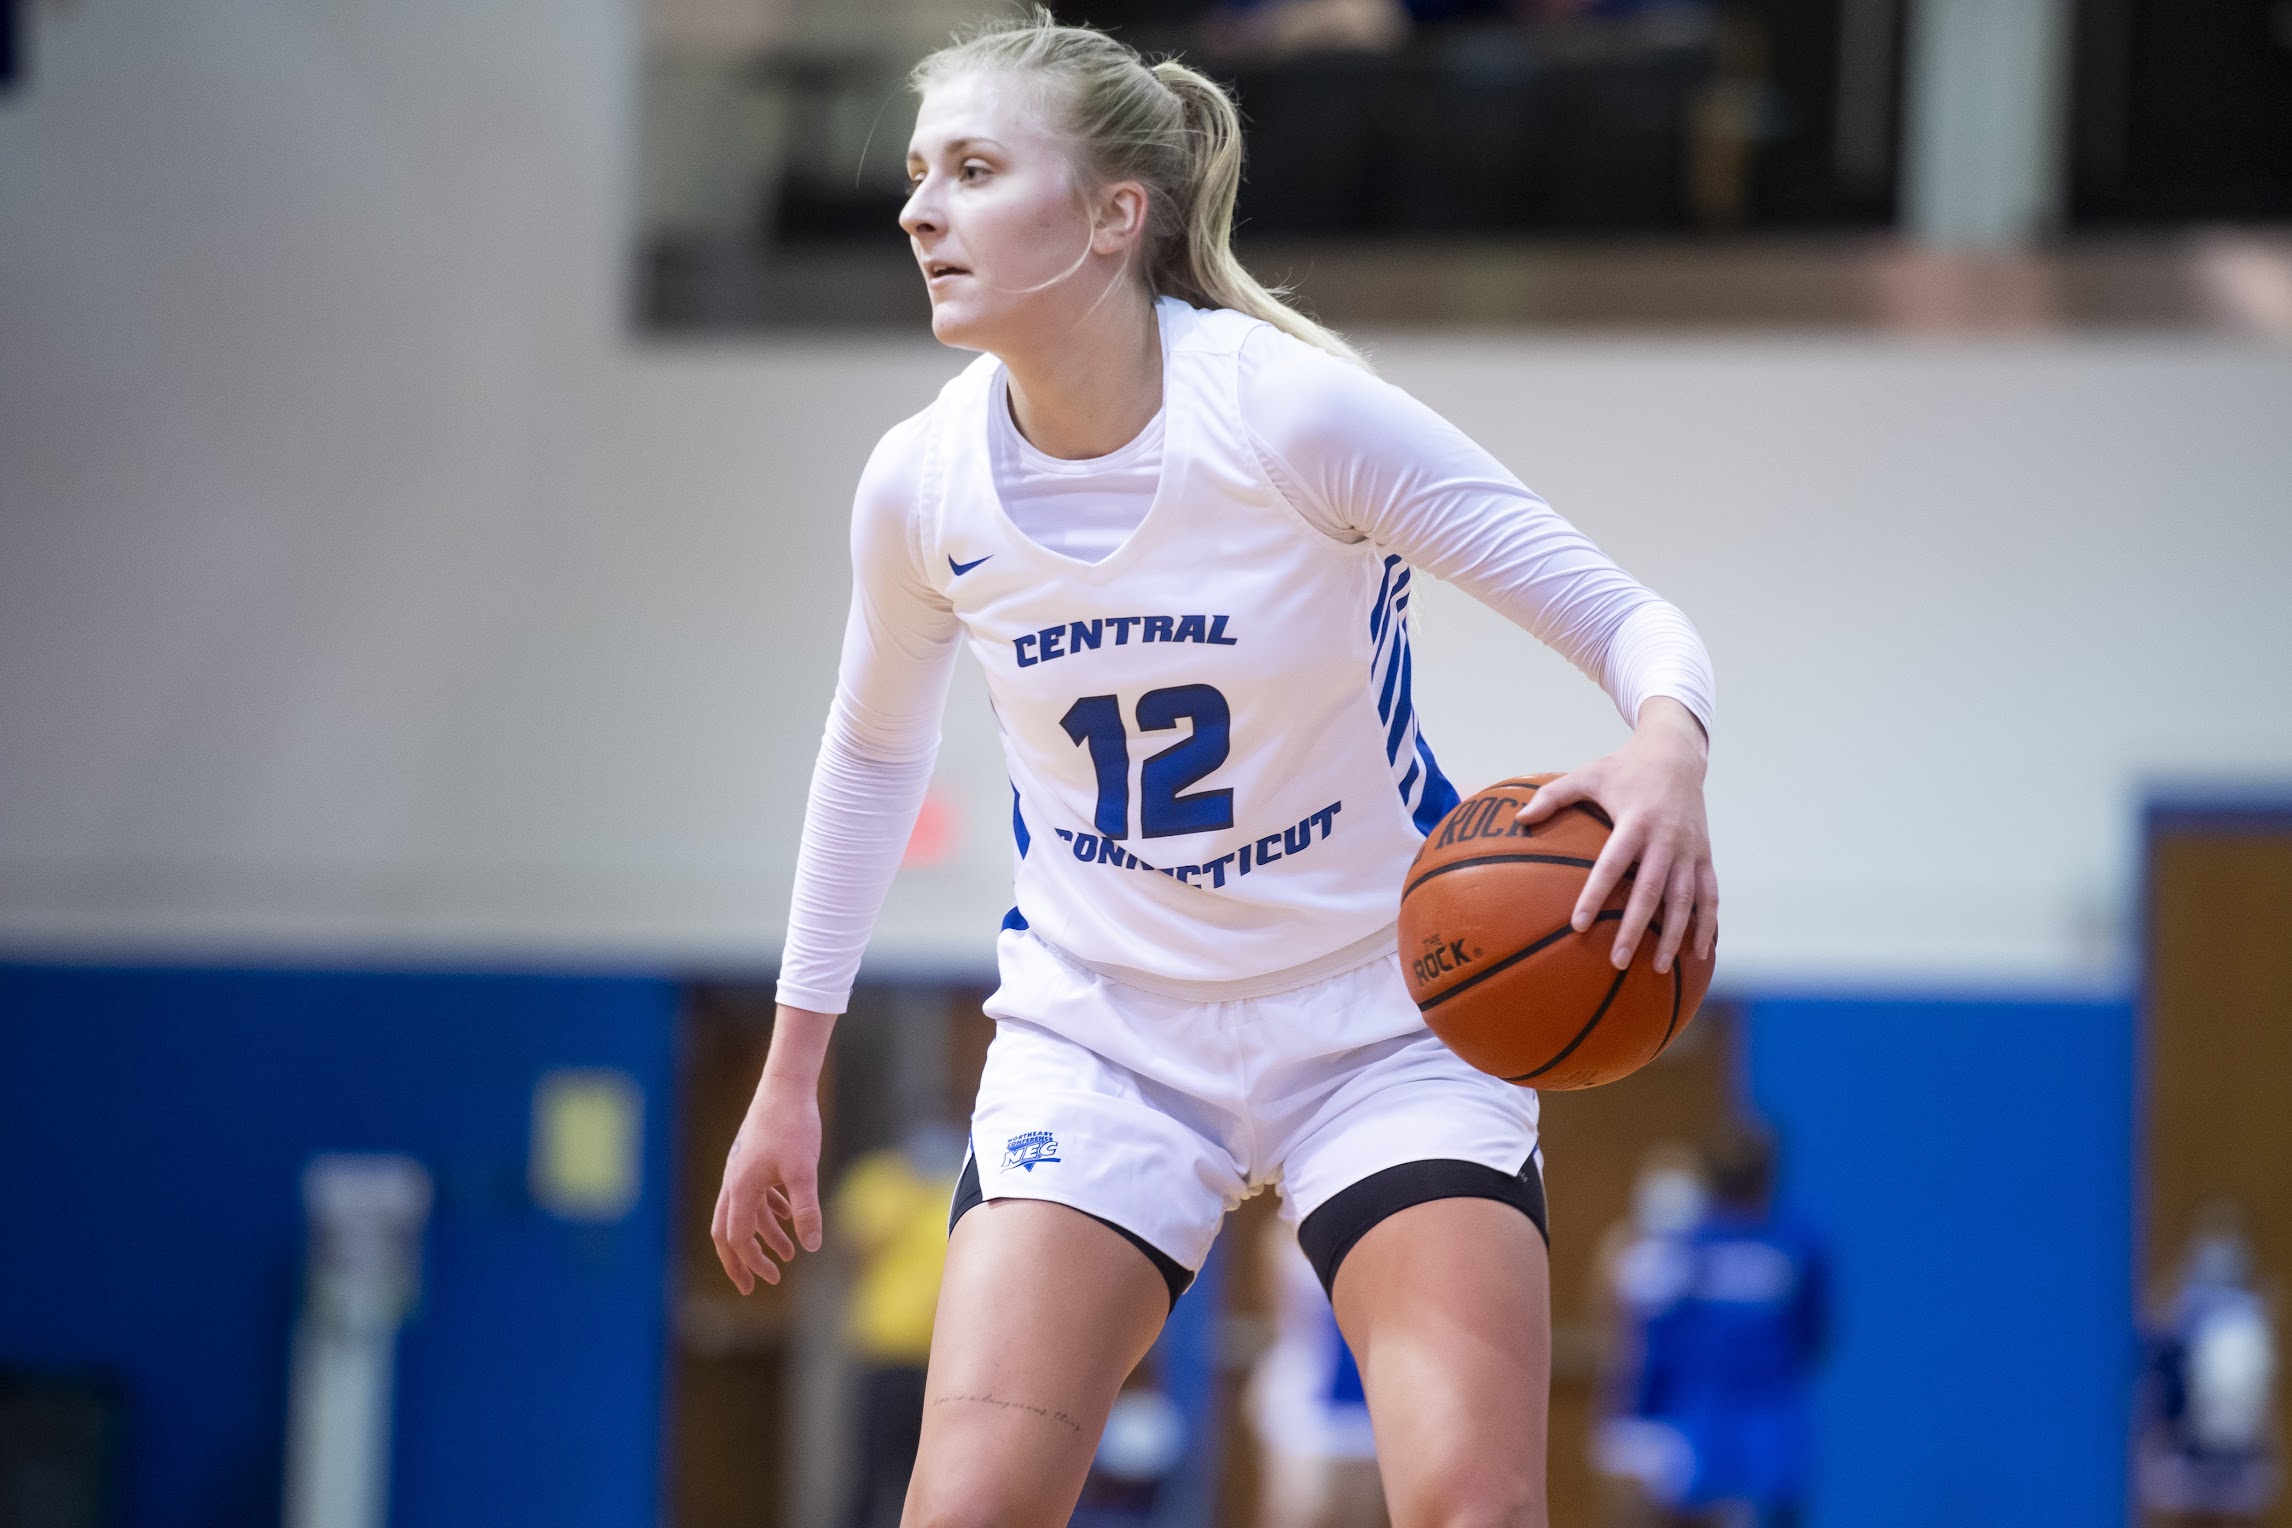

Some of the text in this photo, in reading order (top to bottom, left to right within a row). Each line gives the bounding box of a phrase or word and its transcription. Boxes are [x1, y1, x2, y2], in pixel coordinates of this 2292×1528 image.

[1012, 614, 1238, 668] CENTRAL
[1058, 683, 1235, 841] 12
[1054, 800, 1342, 890] ONCTICUT
[1412, 938, 1471, 987] ROCK
[1000, 1140, 1059, 1168] NEC
[1007, 1131, 1054, 1143] NORTHEAST
